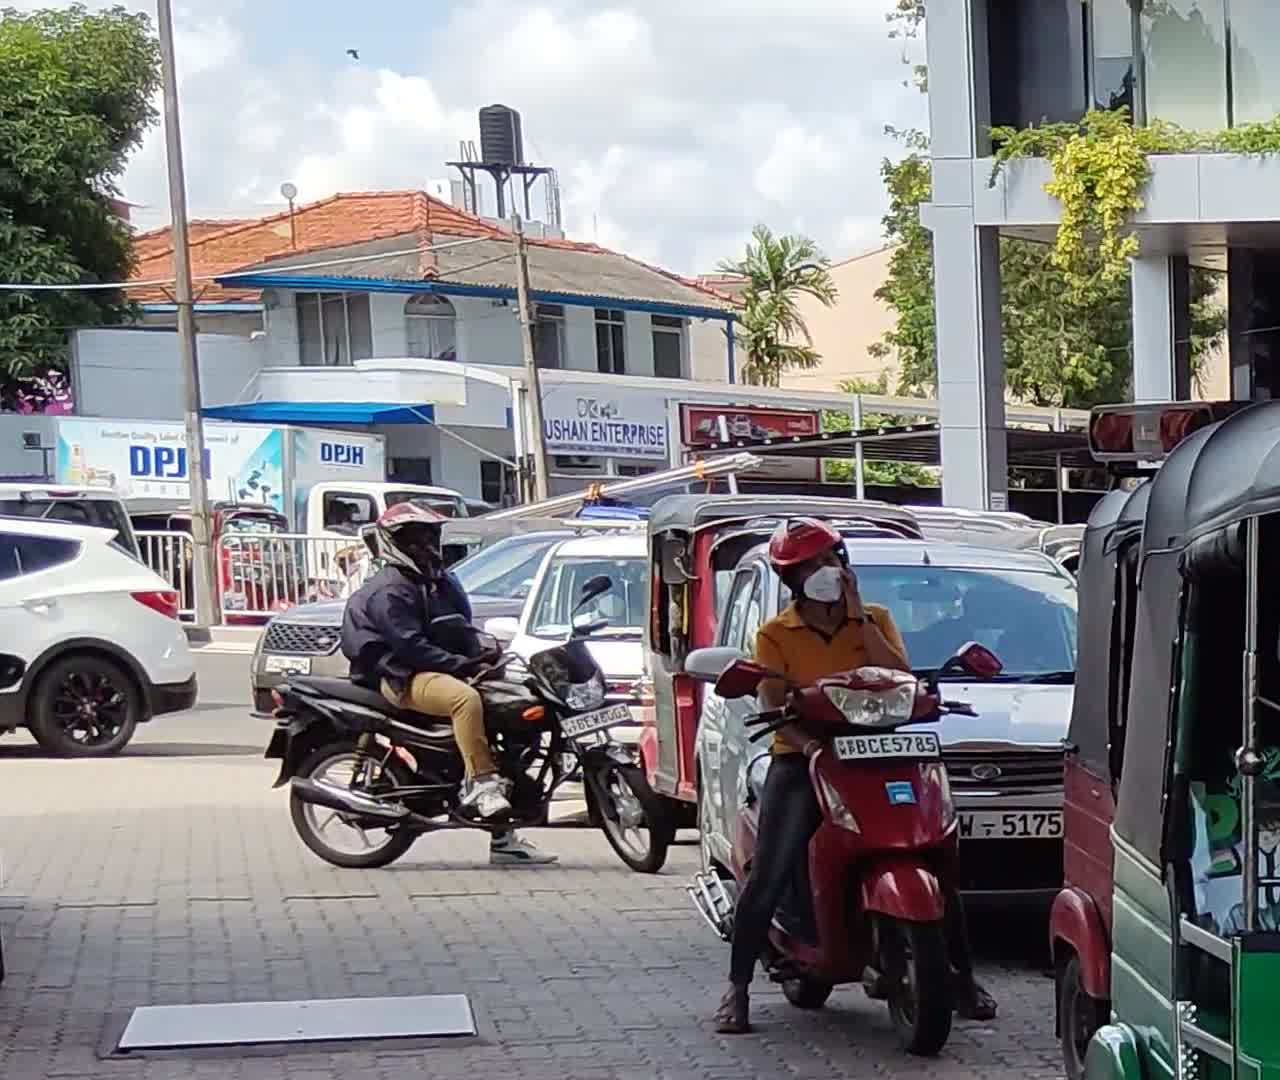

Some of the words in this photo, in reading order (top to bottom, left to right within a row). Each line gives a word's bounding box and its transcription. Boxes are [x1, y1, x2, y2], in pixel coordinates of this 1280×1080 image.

[591, 422, 665, 446] ENTERPRISE
[130, 445, 211, 480] DPJ
[321, 443, 364, 464] DPJH
[856, 736, 936, 755] BCE5785
[1001, 813, 1063, 836] 5175
